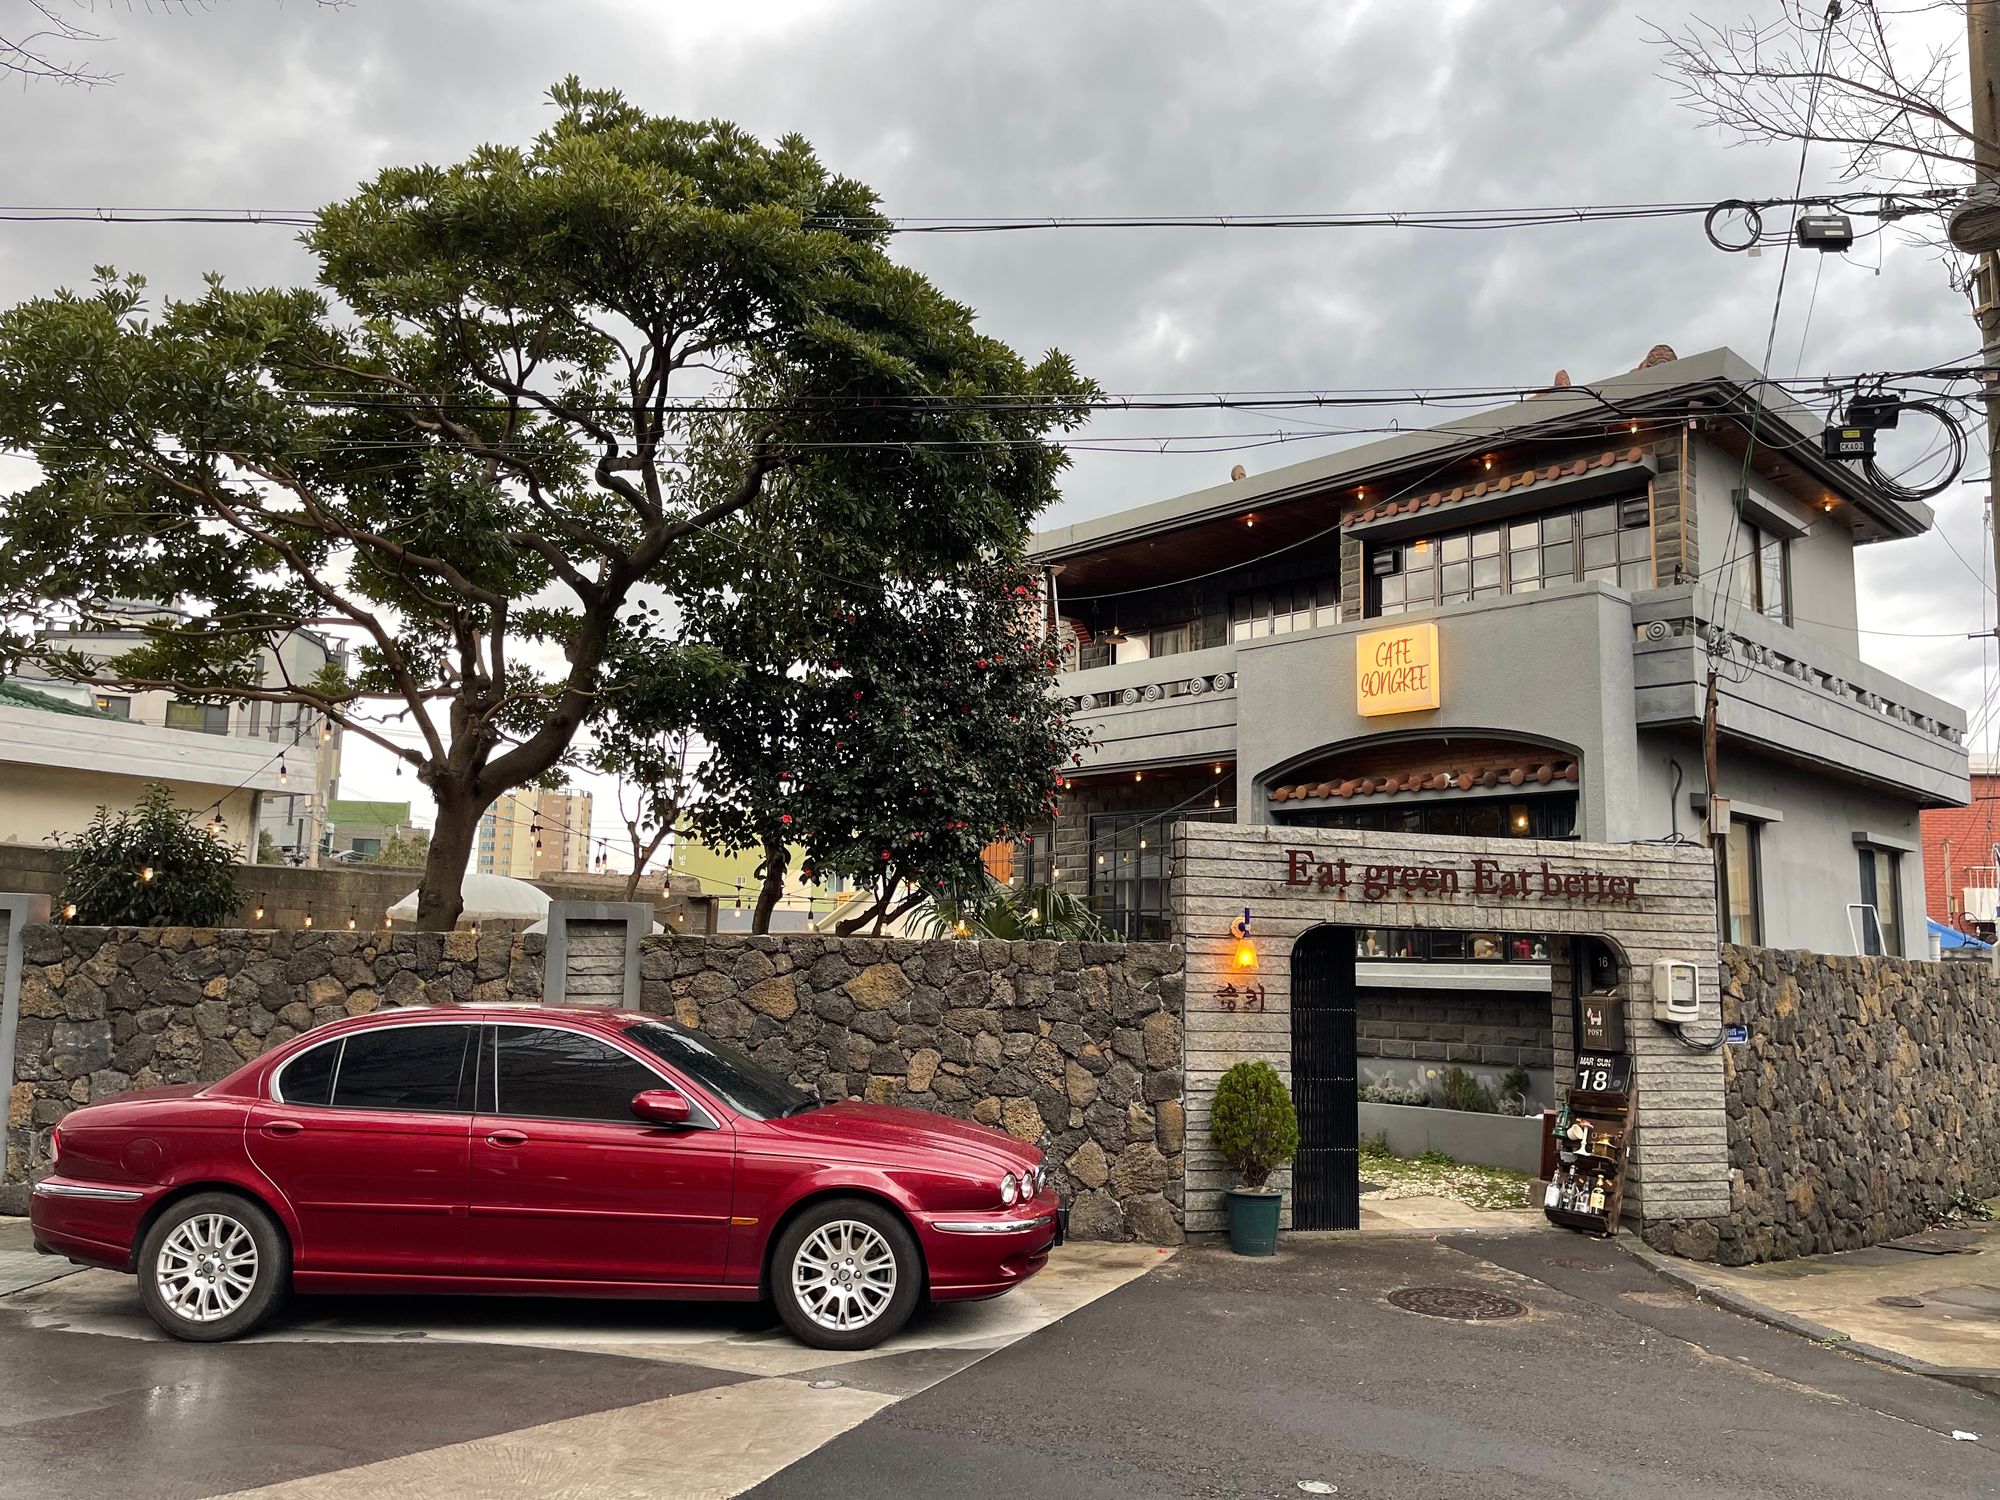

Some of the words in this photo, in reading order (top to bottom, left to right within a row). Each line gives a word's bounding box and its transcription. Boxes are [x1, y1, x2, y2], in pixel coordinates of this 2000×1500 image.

[1375, 638, 1413, 667] CAFE
[1361, 664, 1429, 698] SONGKEE
[1284, 849, 1352, 887] Eat
[1362, 864, 1461, 900] green
[1471, 858, 1533, 898] Eat
[1541, 861, 1641, 901] better
[1598, 956, 1608, 968] 16
[1587, 1028, 1603, 1037] POST
[1579, 1056, 1594, 1066] MAR
[1596, 1057, 1612, 1068] SUN
[1579, 1069, 1608, 1092] 18
